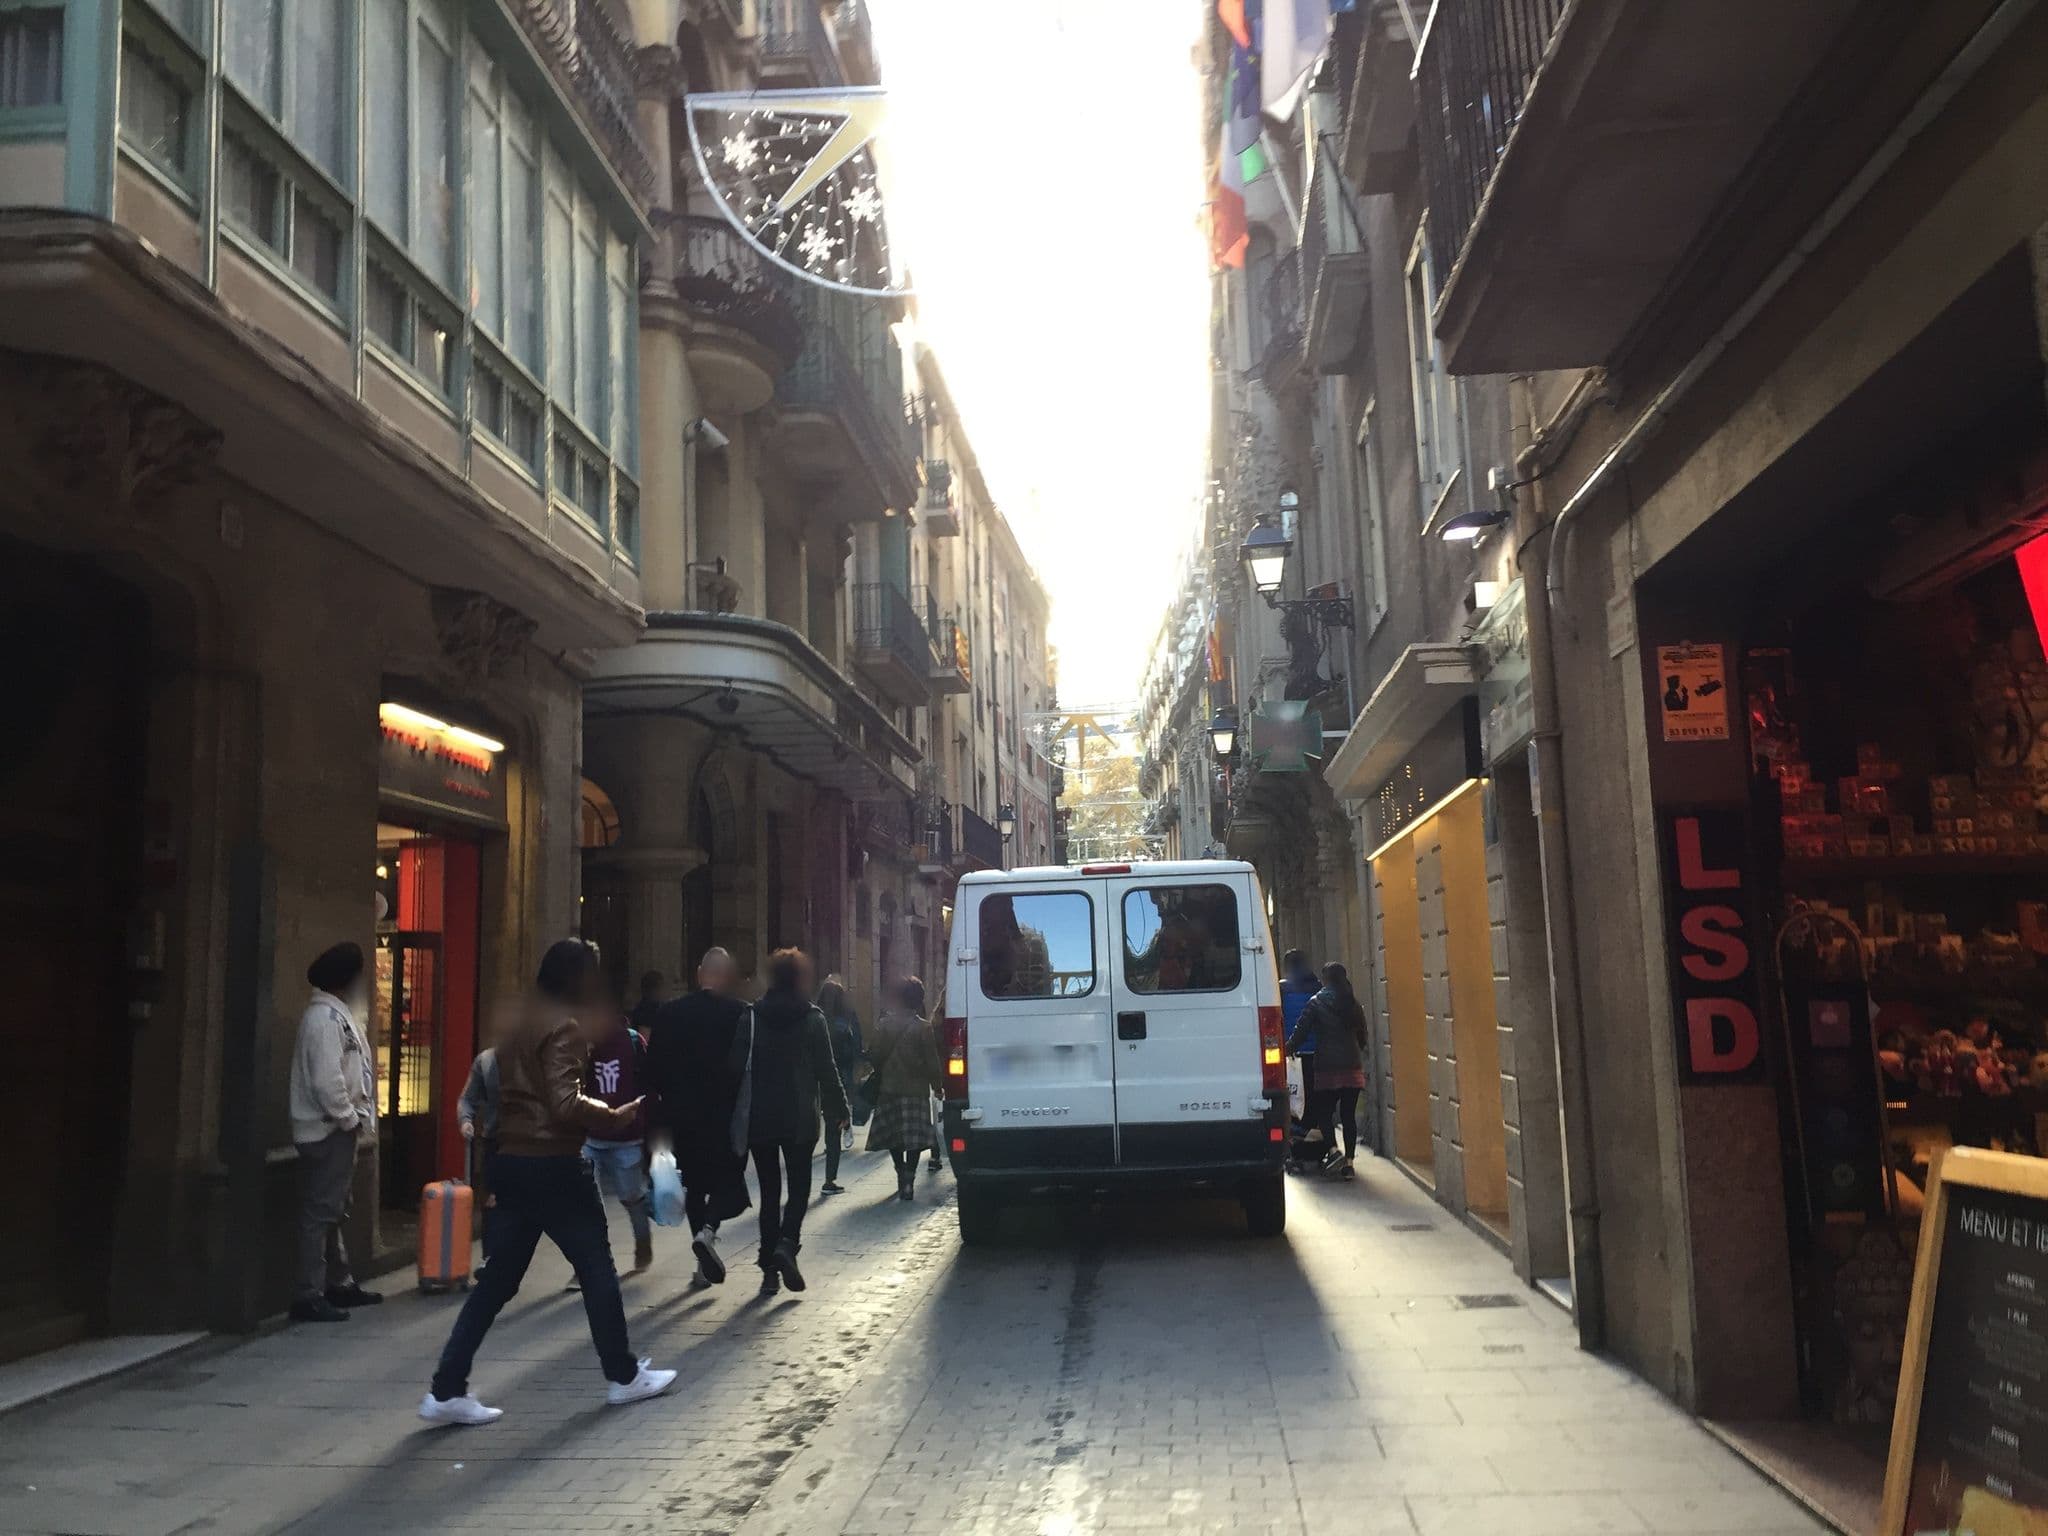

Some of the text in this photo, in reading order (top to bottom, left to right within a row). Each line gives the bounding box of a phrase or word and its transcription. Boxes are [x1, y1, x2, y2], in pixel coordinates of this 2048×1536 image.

[1675, 817, 1760, 1073] LSD
[1000, 1100, 1232, 1118] PEUGEOT BOXER
[1960, 1206, 2007, 1243] MENU
[2011, 1217, 2032, 1248] ET
